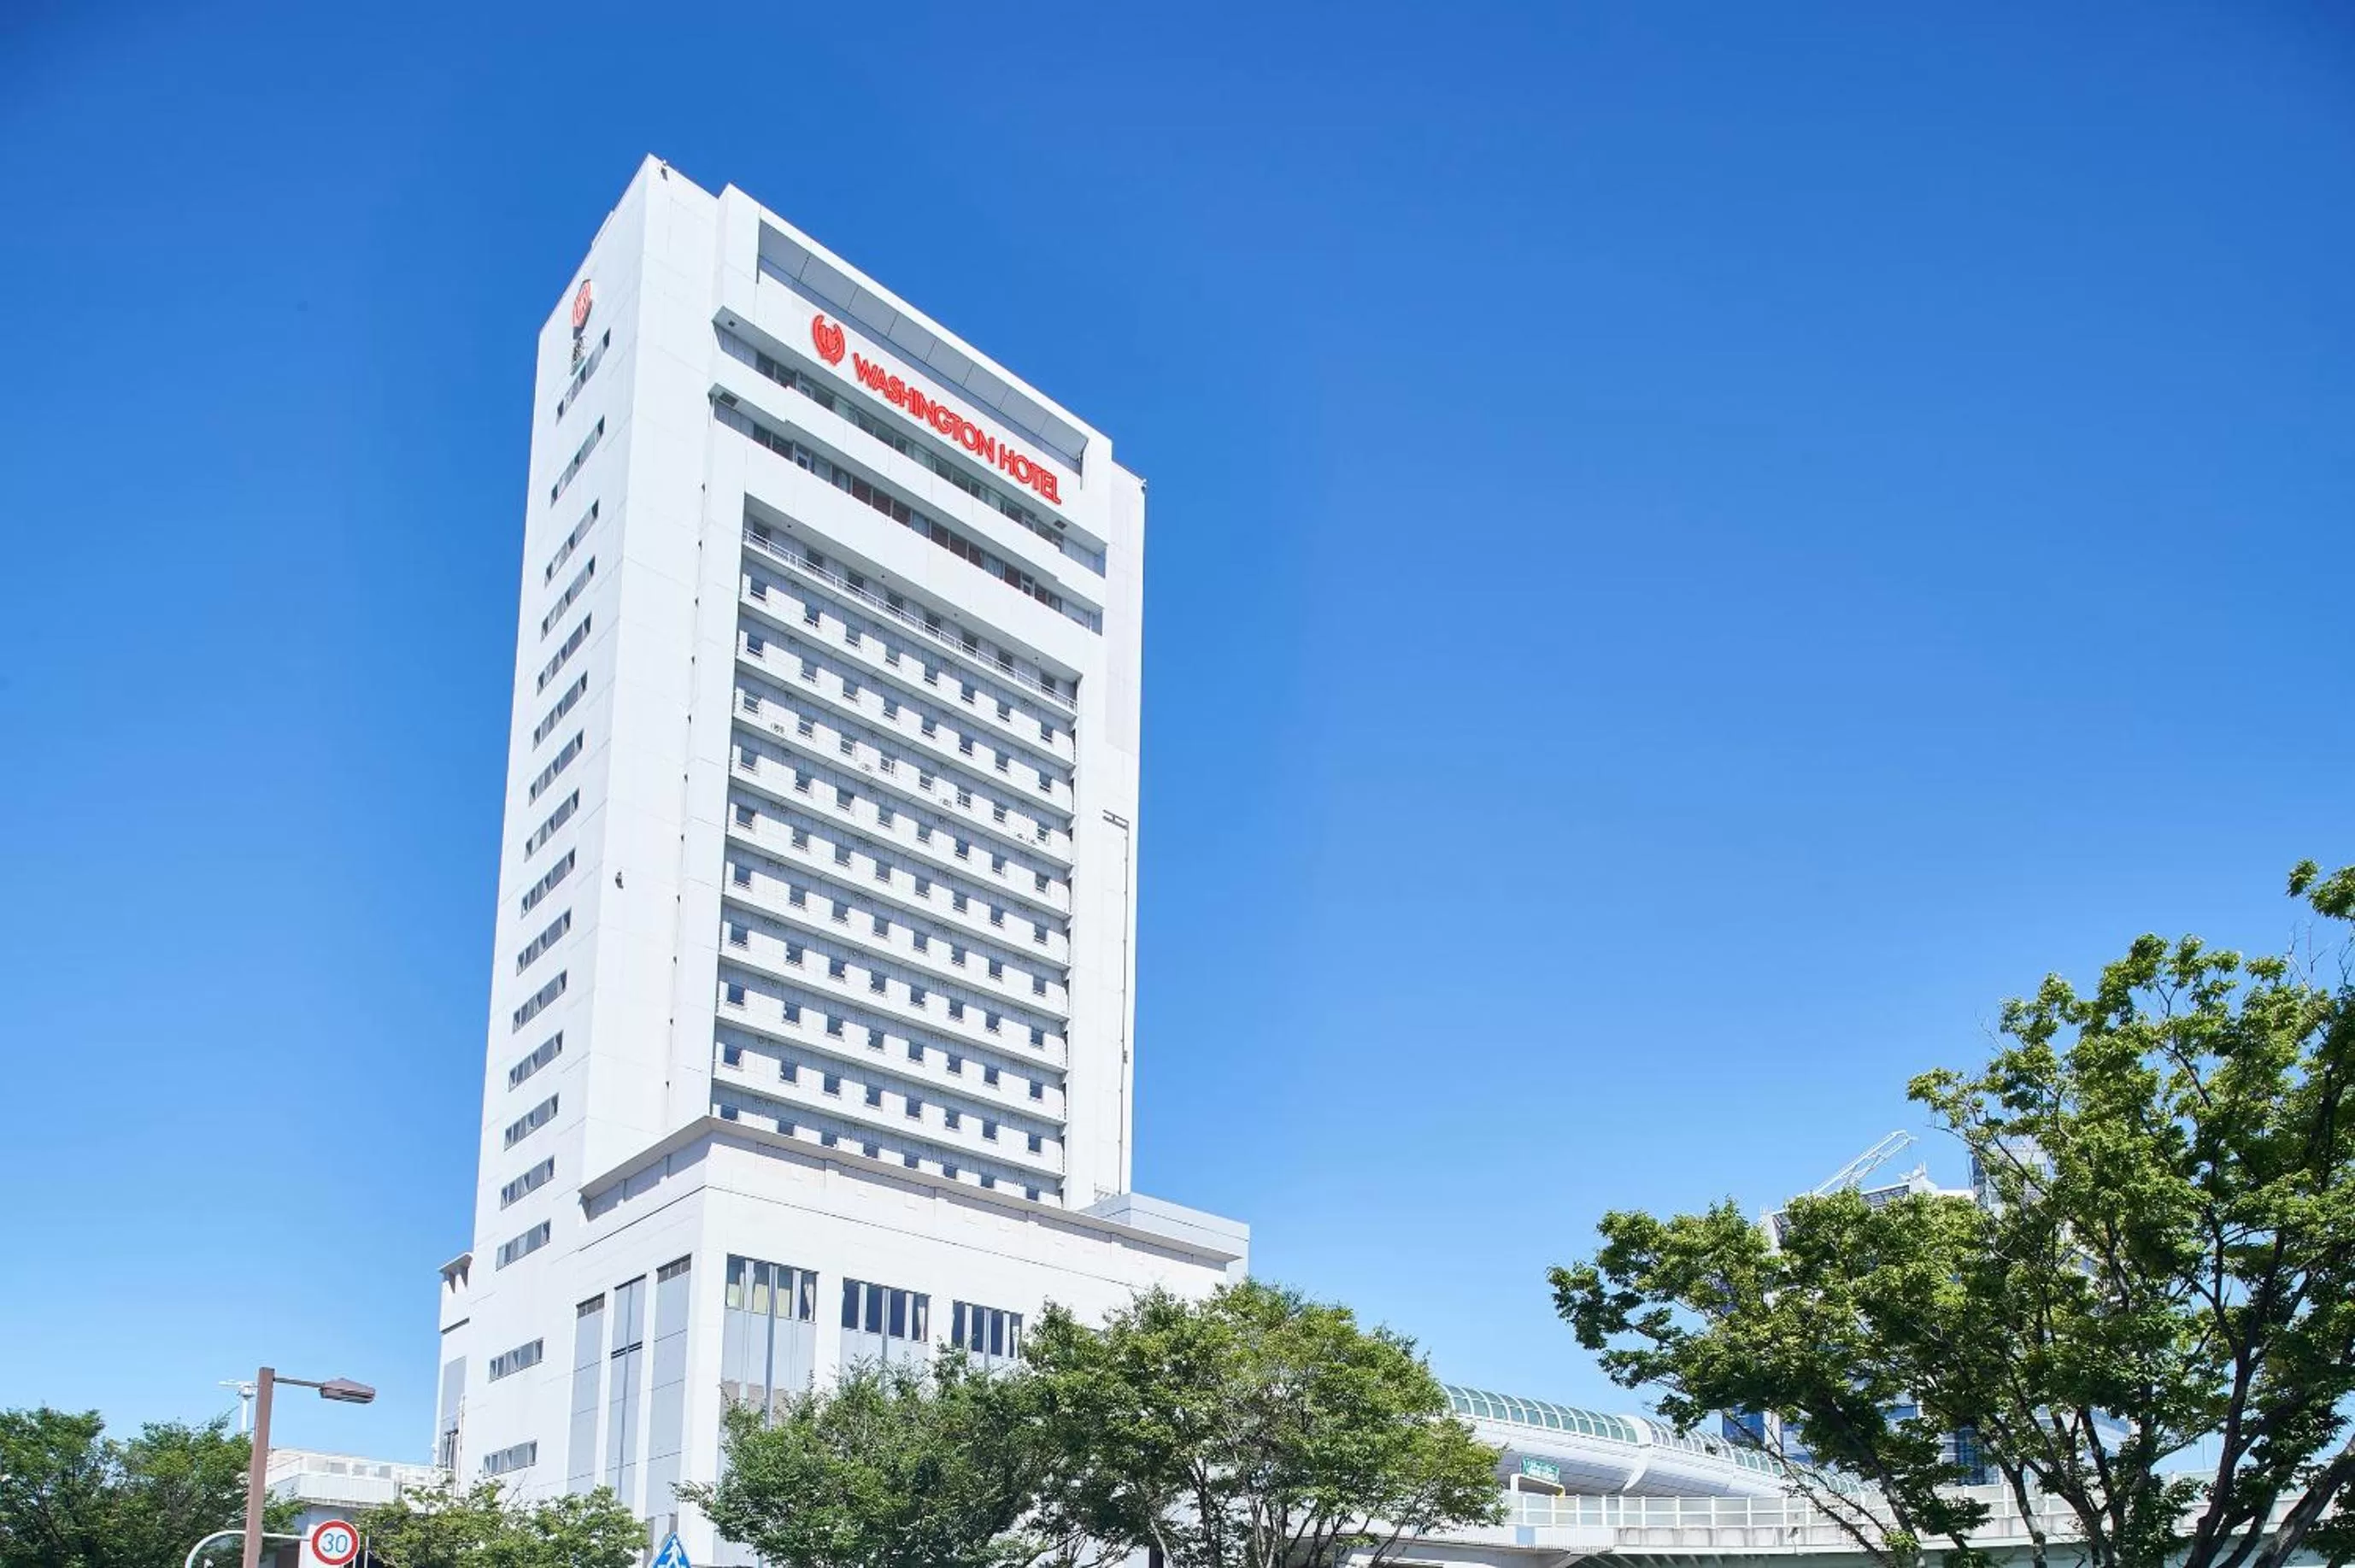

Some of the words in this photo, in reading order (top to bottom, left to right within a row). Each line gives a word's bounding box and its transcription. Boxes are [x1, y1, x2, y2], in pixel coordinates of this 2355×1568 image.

[852, 351, 995, 463] WASHINGTON
[999, 443, 1062, 504] HOTEL
[322, 1533, 348, 1553] 30
